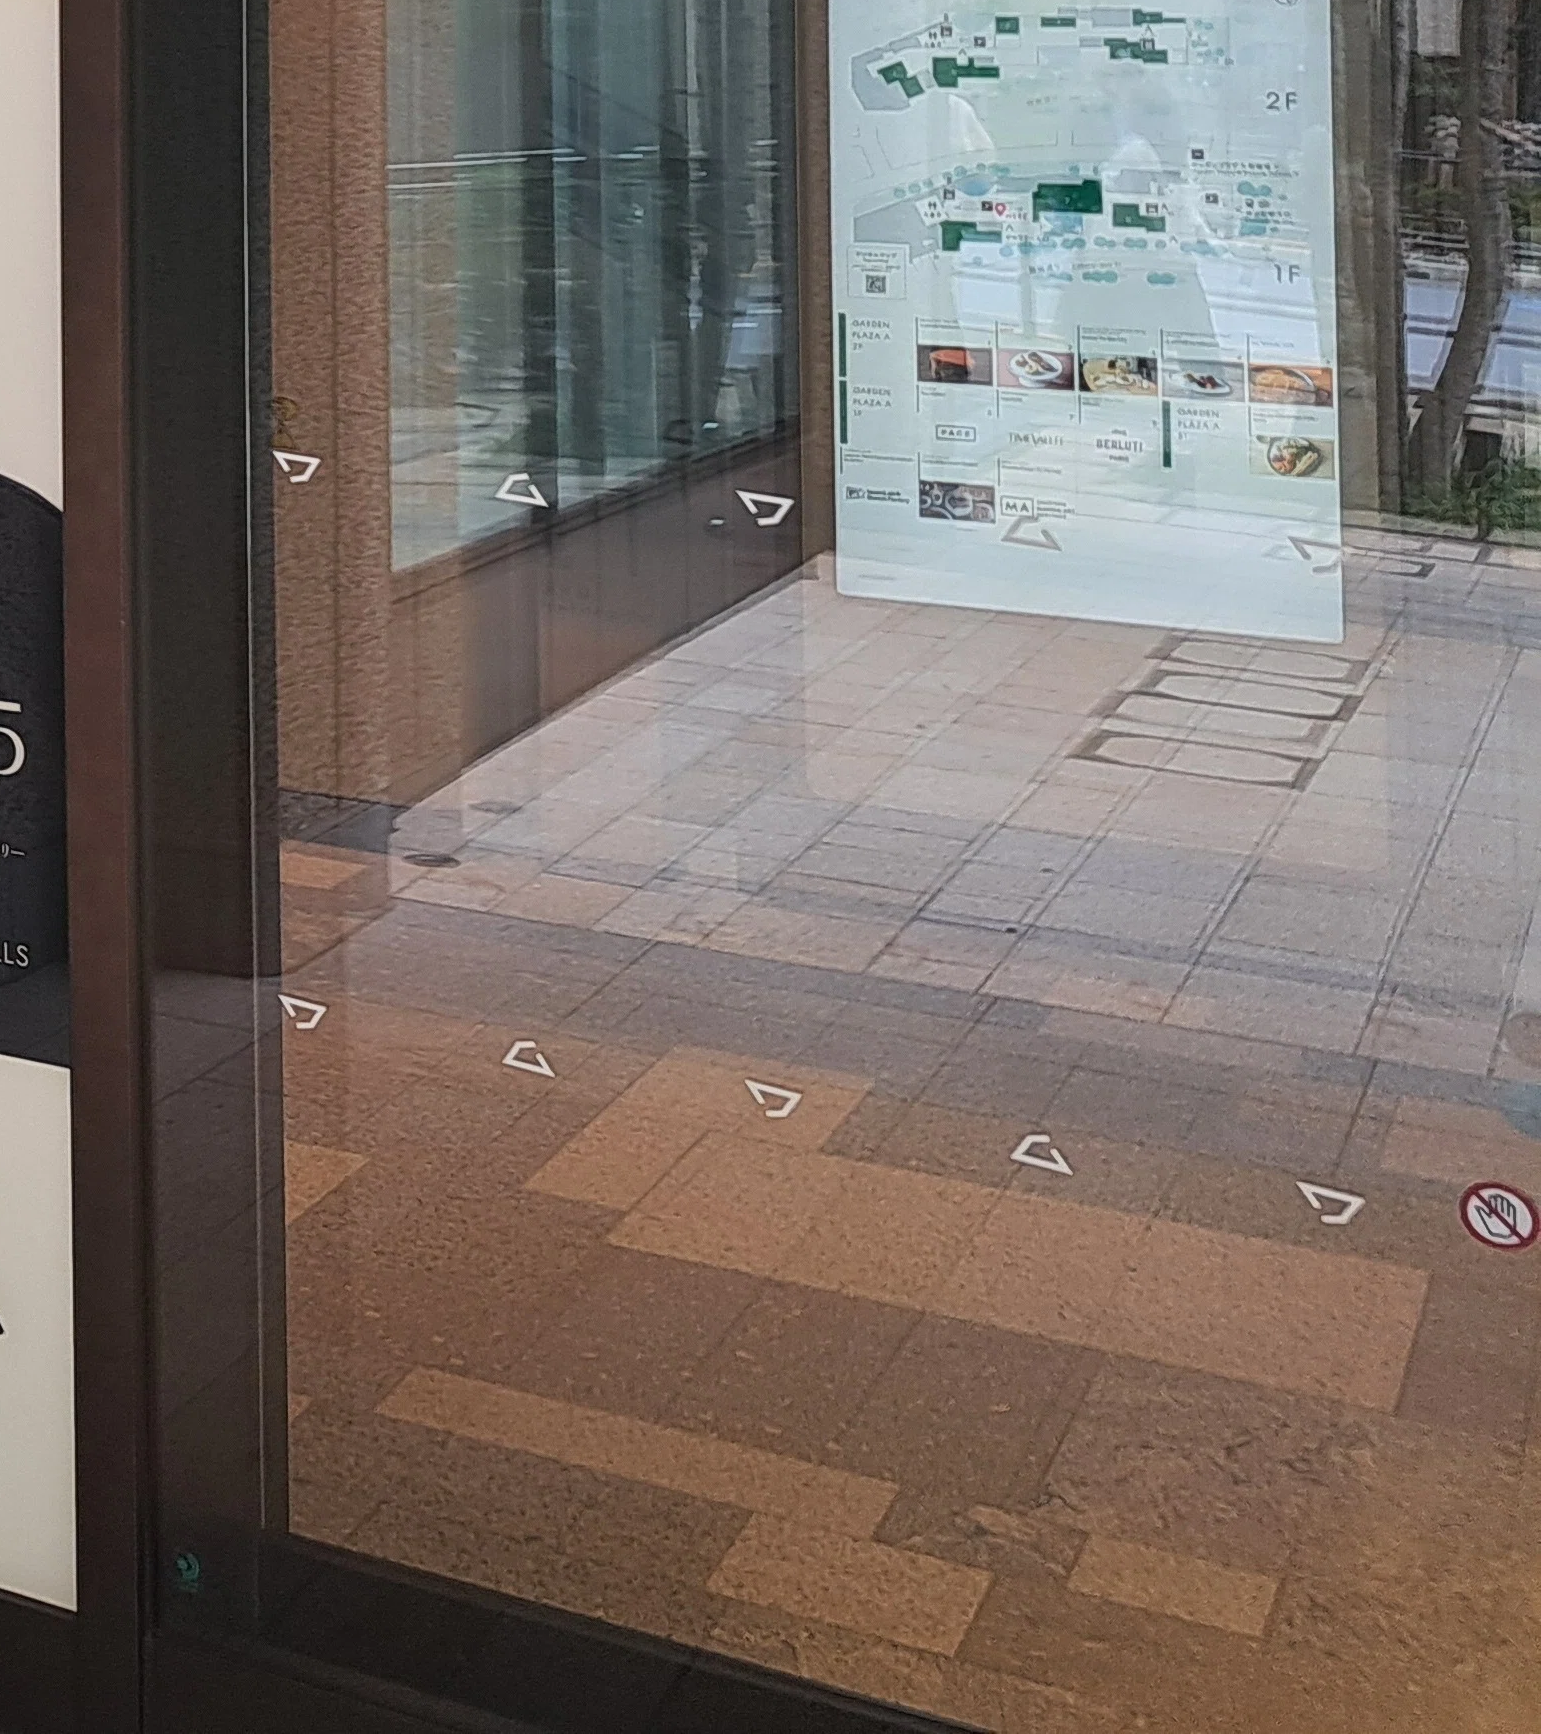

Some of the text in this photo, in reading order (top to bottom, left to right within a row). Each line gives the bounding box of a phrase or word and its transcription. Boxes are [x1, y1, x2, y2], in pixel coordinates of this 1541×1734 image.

[1265, 91, 1298, 112] 2F
[1273, 263, 1301, 285] 1F
[1096, 439, 1144, 454] BERLUTI
[1005, 501, 1030, 514] MA
